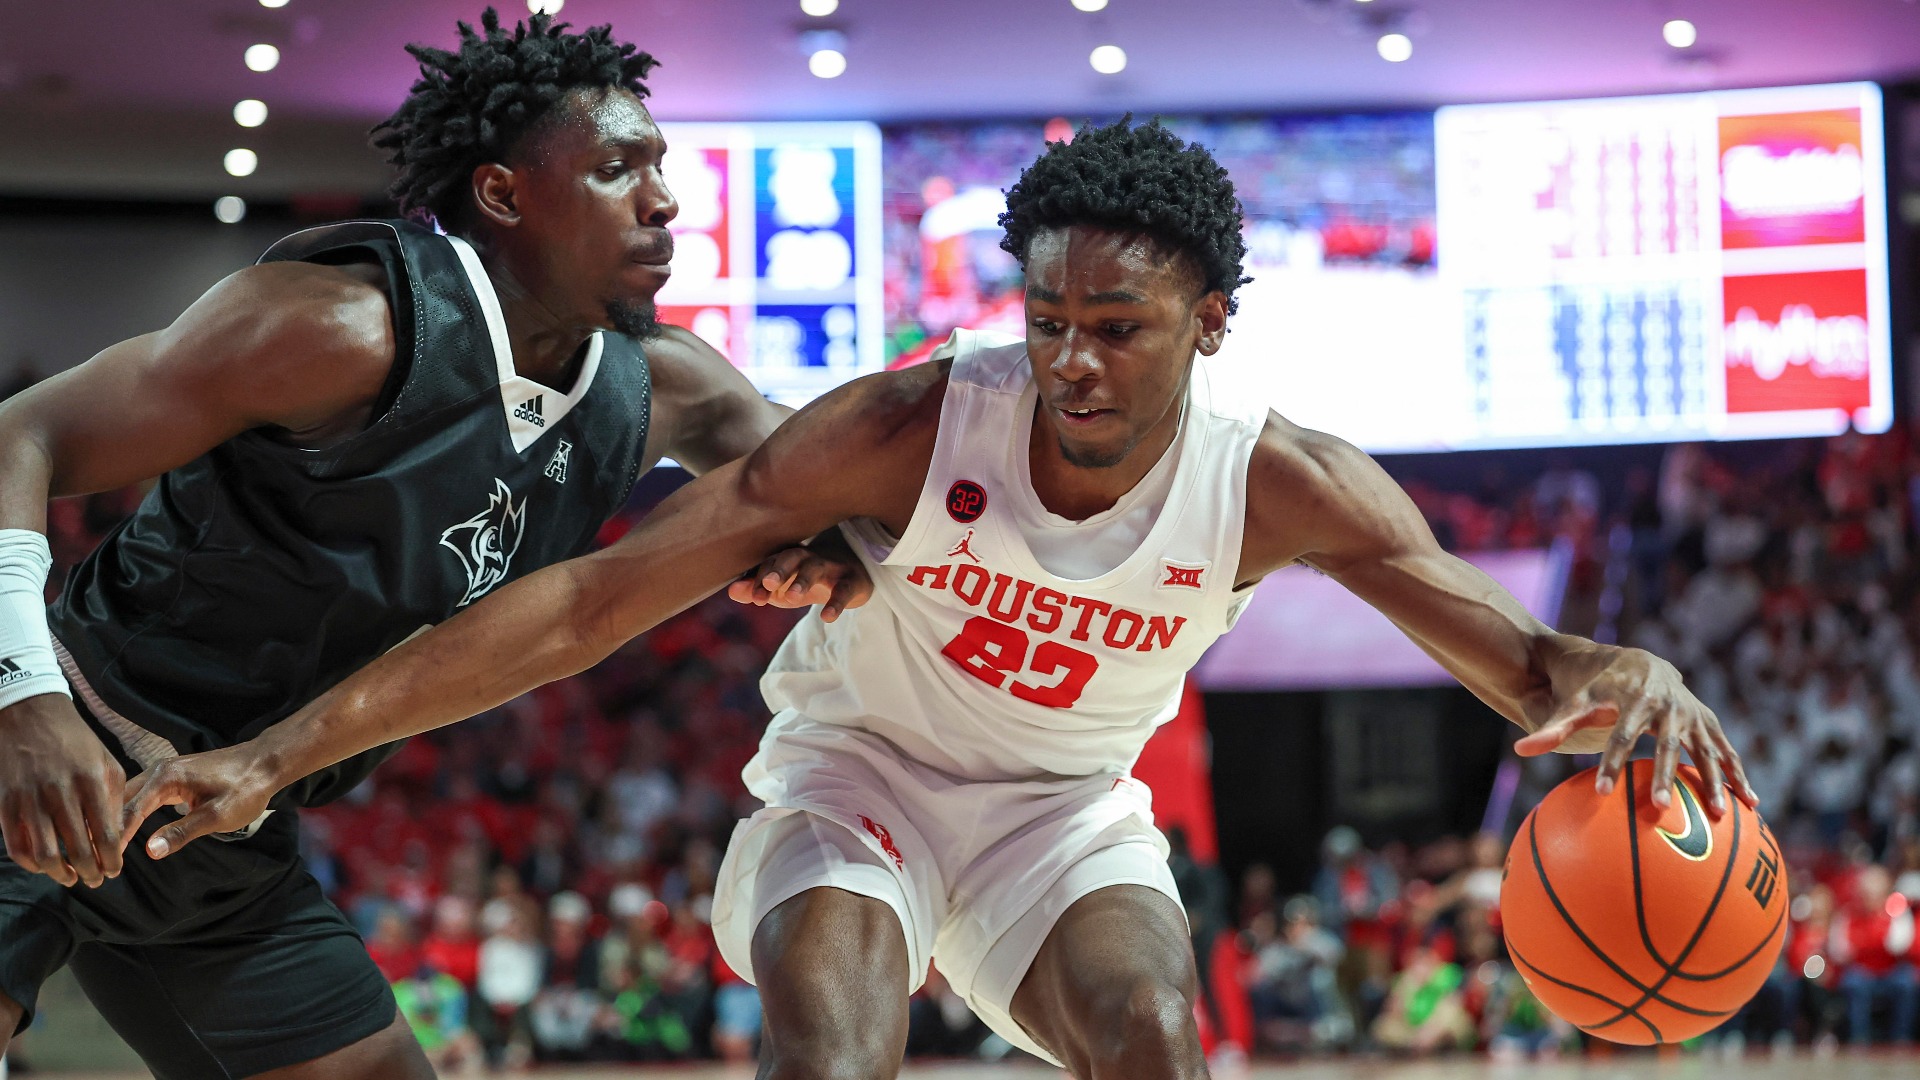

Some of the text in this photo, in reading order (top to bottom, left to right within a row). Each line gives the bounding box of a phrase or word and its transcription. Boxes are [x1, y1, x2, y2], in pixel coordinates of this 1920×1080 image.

[514, 408, 545, 428] adidas
[952, 488, 980, 515] 32
[1163, 565, 1205, 588] XII
[907, 564, 1187, 652] HOUSTON
[0, 670, 32, 685] idas
